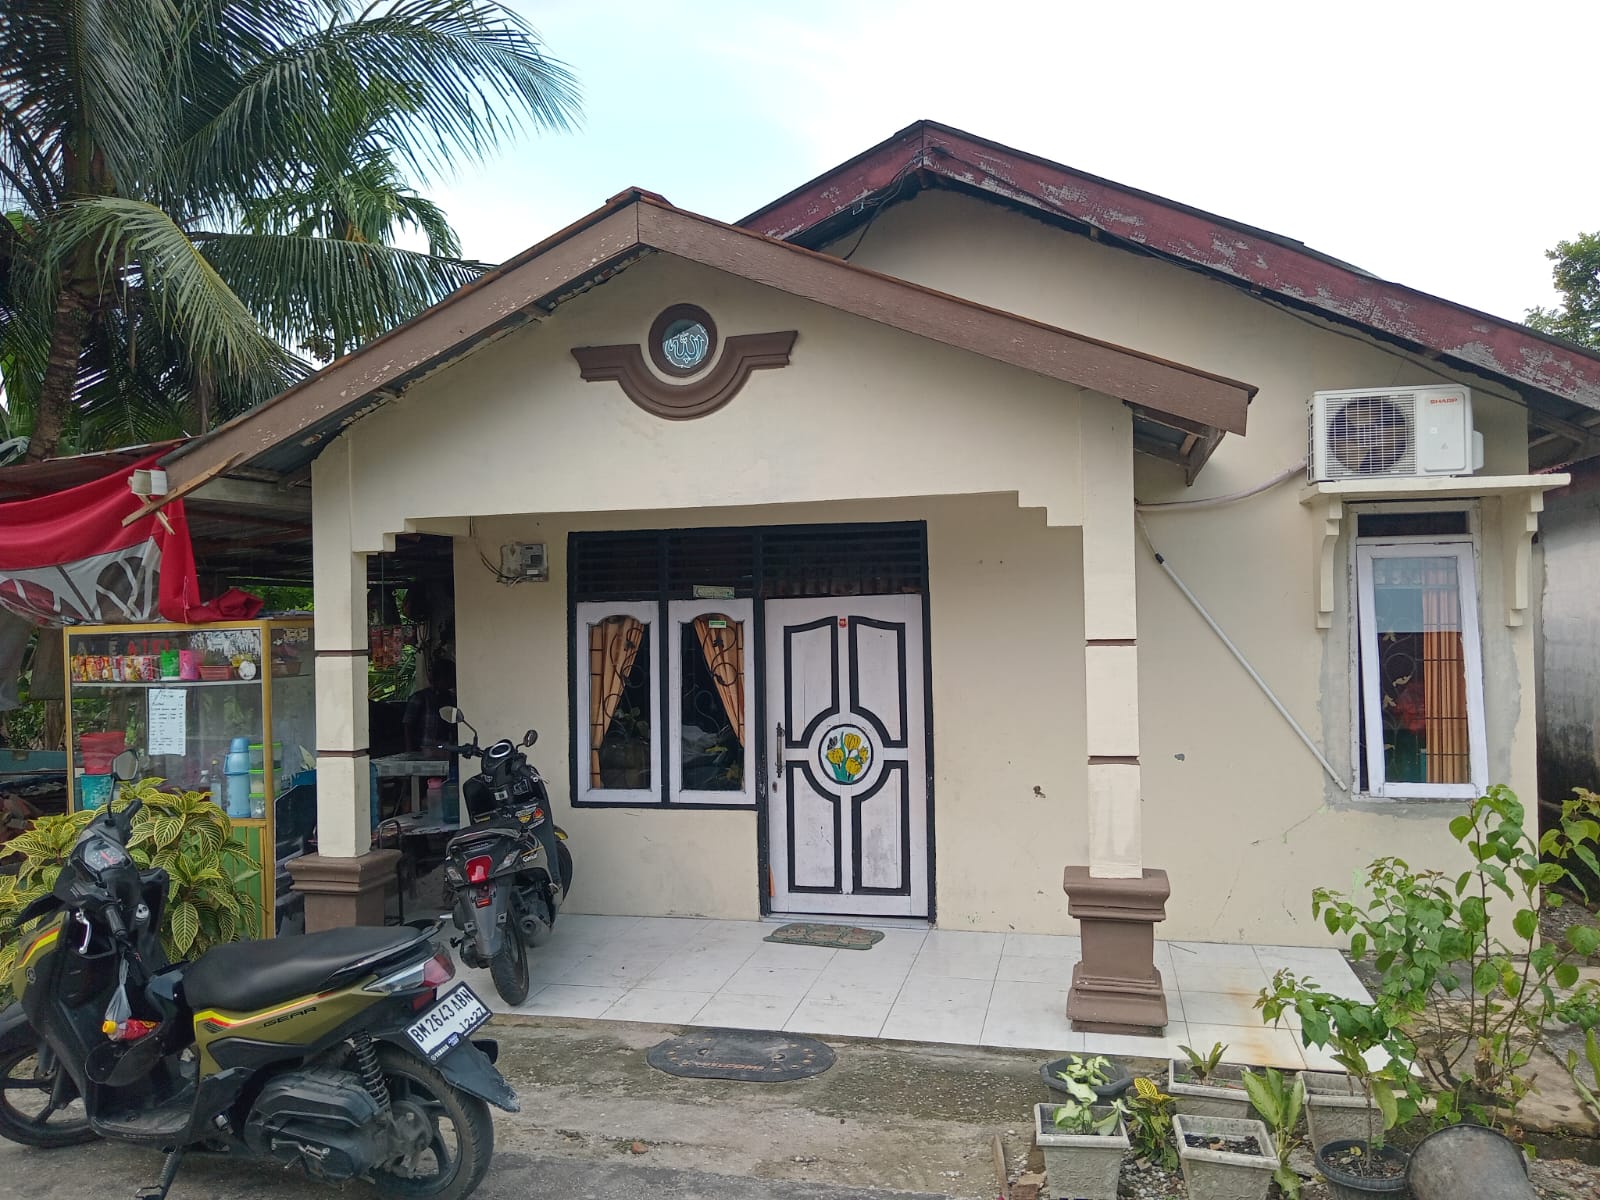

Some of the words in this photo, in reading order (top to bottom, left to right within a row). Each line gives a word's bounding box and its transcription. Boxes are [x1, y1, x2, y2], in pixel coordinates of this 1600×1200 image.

[264, 1007, 317, 1027] GEAR
[410, 1027, 431, 1043] BM
[426, 1004, 455, 1032] 2643
